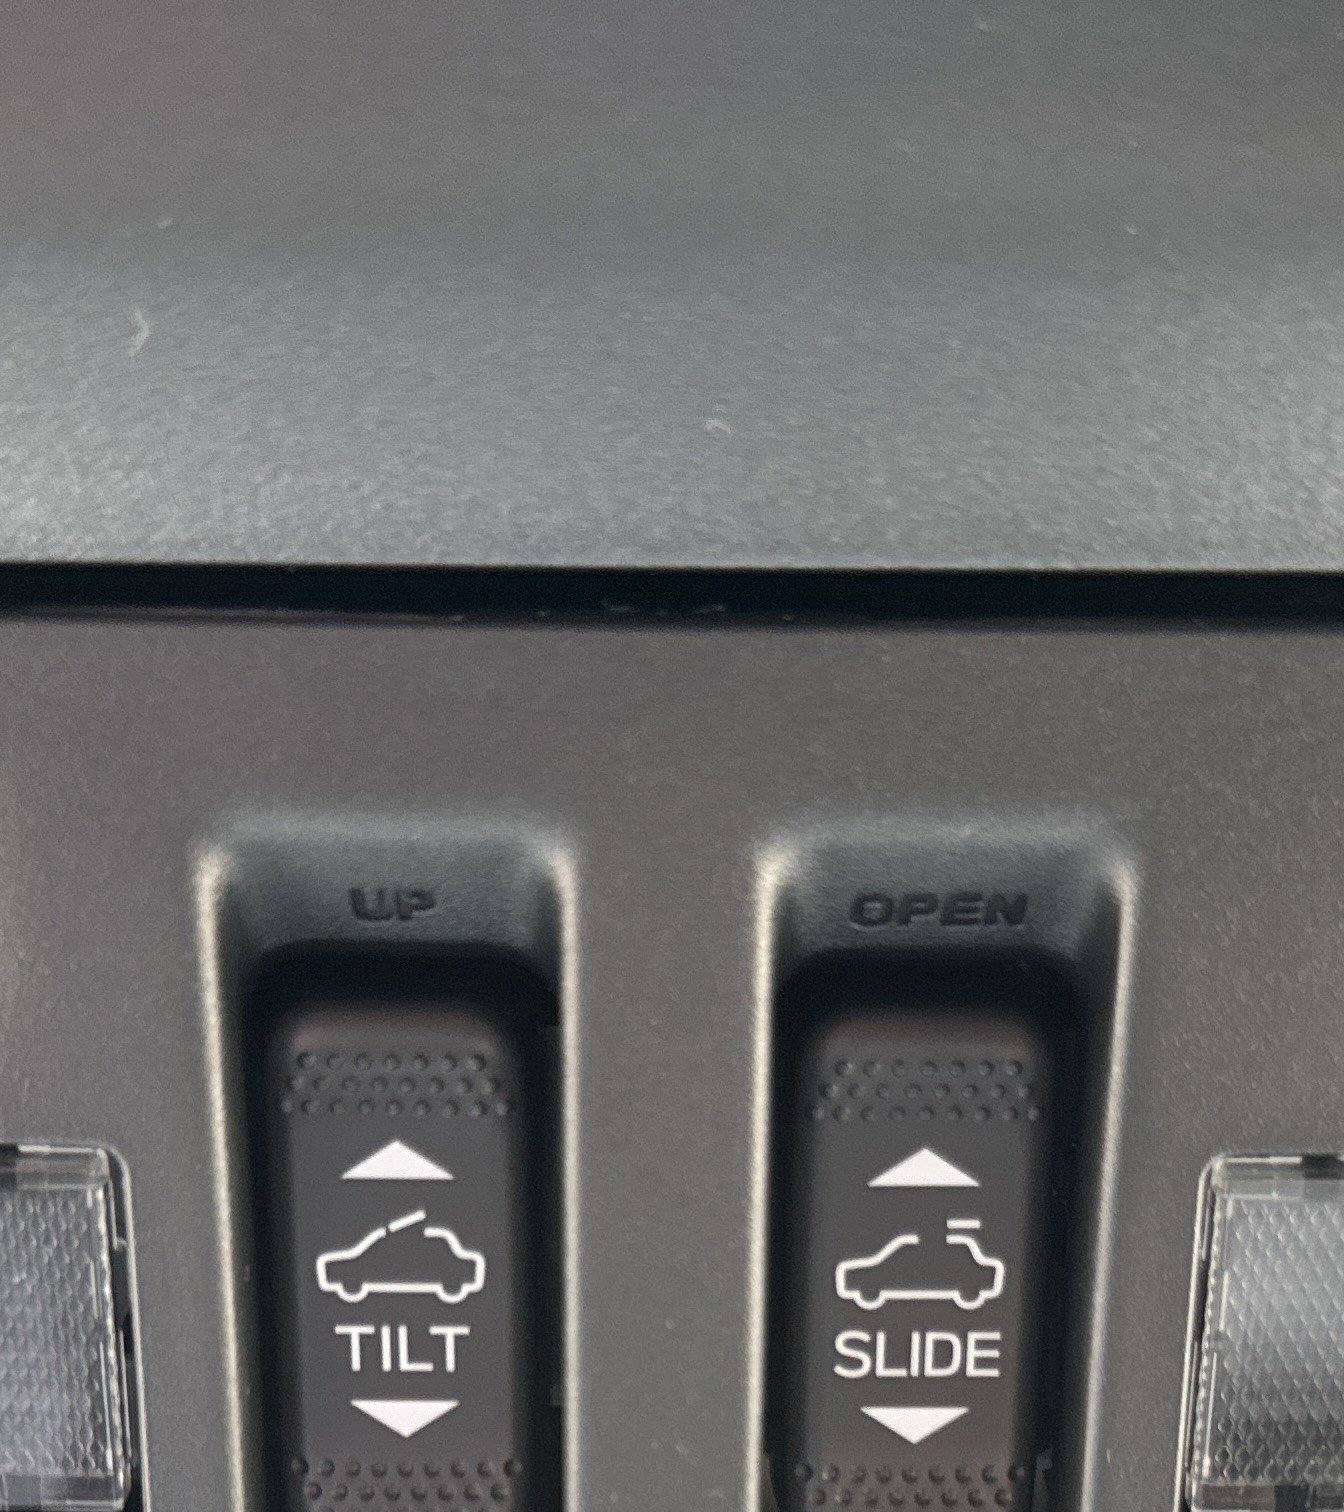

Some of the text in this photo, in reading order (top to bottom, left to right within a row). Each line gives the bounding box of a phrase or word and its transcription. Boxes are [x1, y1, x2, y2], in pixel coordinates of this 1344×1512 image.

[348, 886, 438, 922] UP
[848, 891, 1030, 927] OPEN
[335, 1325, 471, 1373] TILT
[833, 1330, 1002, 1378] SLIDE
